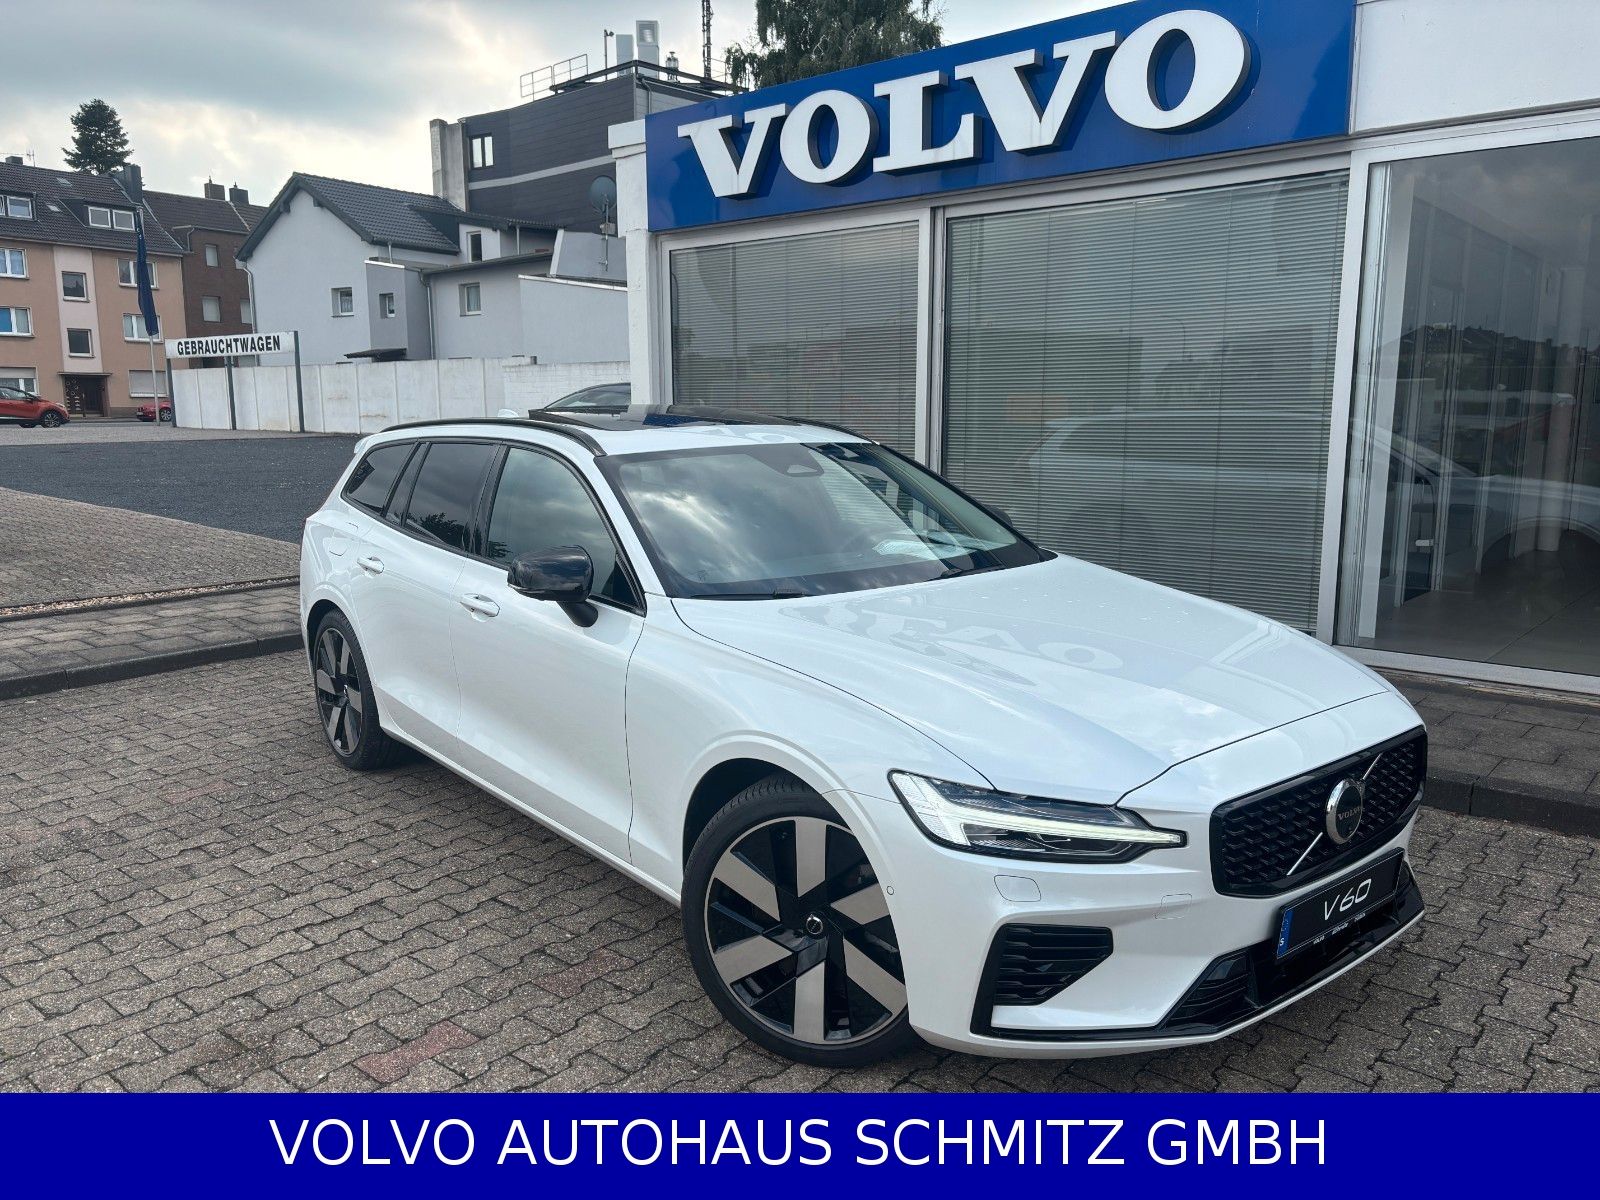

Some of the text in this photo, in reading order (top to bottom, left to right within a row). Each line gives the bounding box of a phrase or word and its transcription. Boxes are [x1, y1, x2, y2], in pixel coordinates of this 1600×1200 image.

[678, 9, 1248, 198] VOLVO
[177, 335, 281, 356] GEBRAUCHTWAGEN
[1324, 878, 1372, 921] V60
